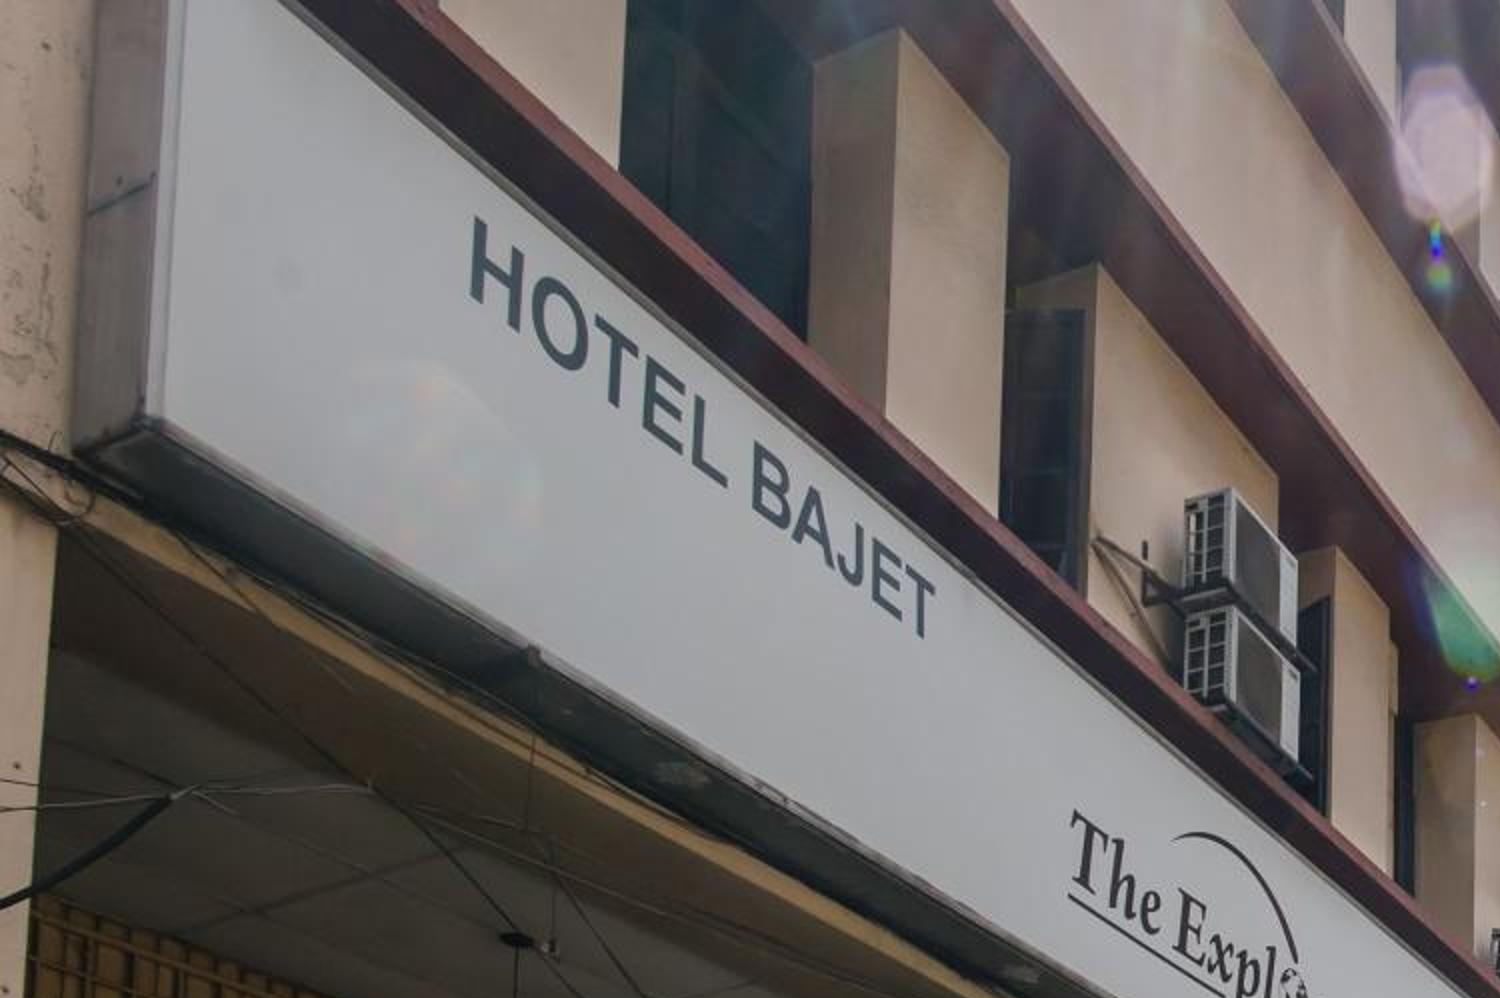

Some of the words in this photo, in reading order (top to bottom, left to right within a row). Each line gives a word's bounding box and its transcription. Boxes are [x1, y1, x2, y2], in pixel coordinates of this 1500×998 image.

[469, 216, 729, 488] HOTEL
[751, 440, 936, 639] BAJET
[1069, 808, 1162, 936] The
